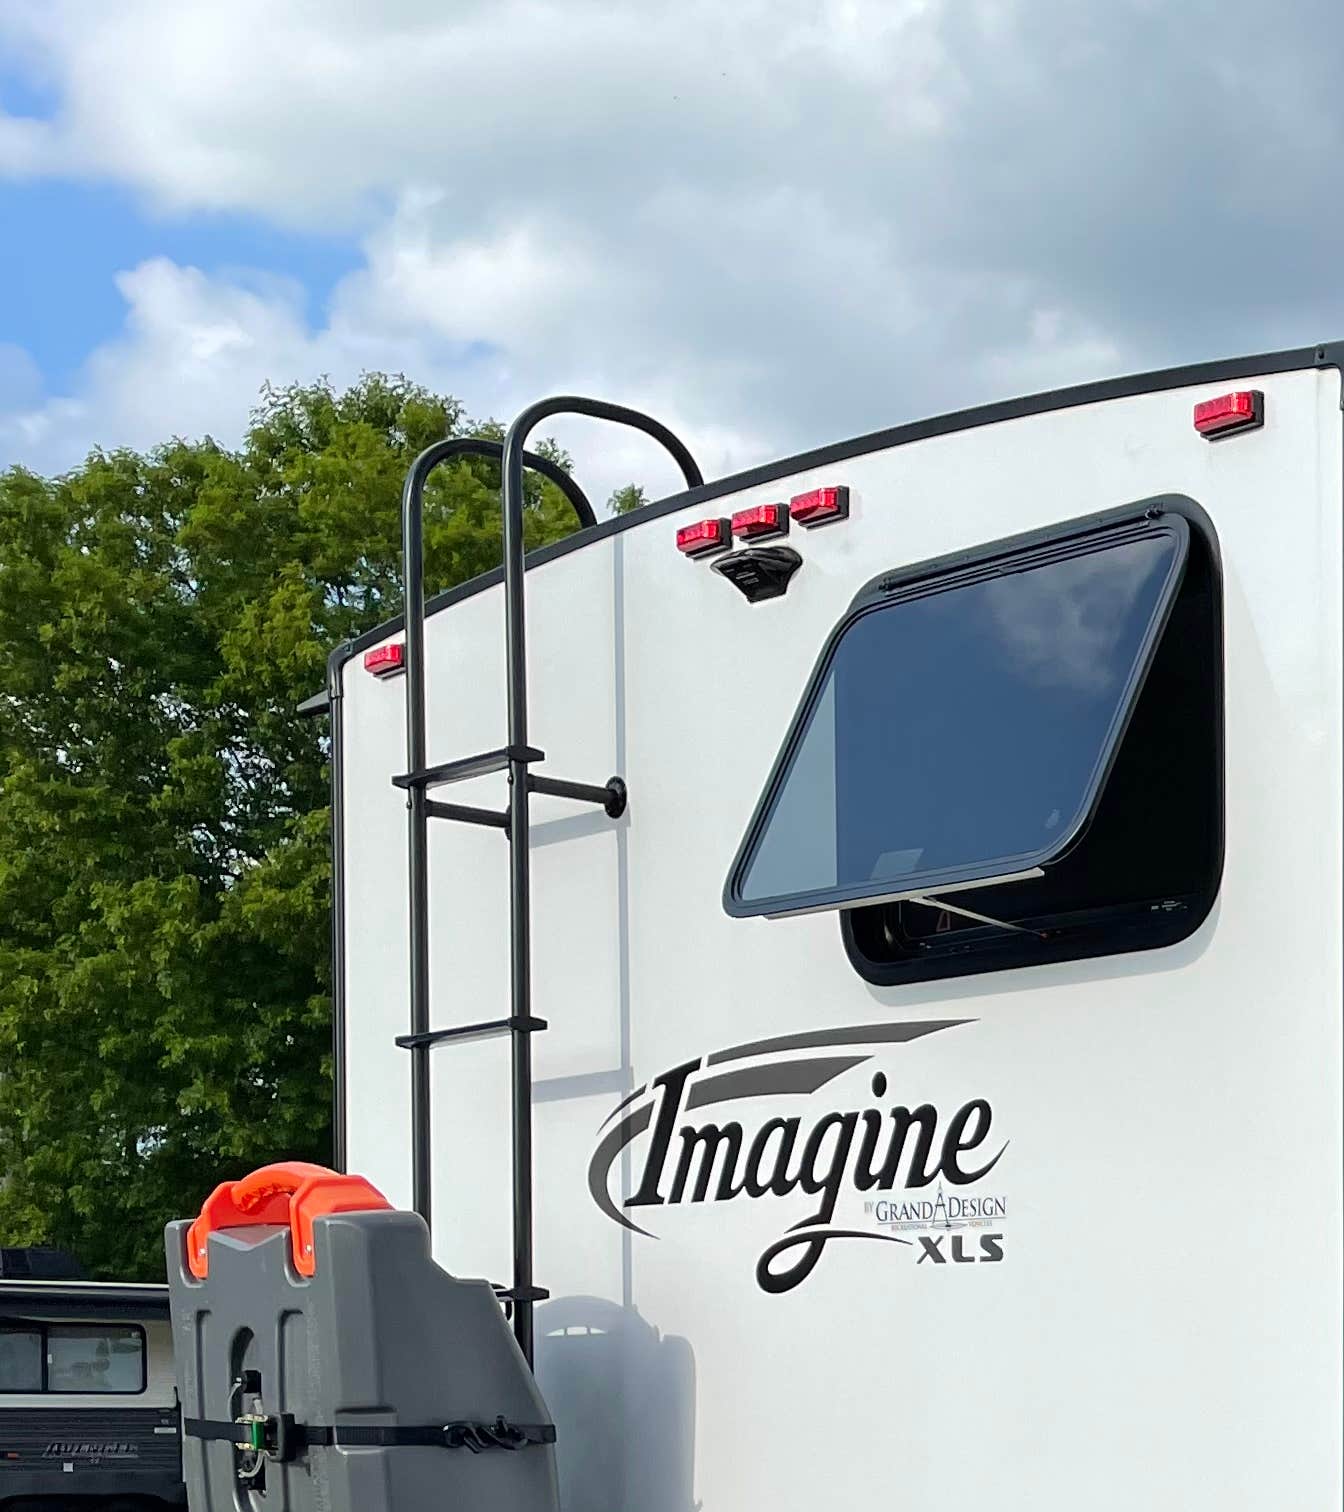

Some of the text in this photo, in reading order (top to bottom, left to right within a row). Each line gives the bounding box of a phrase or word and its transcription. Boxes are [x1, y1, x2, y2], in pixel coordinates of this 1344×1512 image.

[623, 1057, 1011, 1294] Imagine
[876, 1200, 934, 1222] GRAND
[948, 1196, 1006, 1218] DESIGN
[917, 1234, 1004, 1264] XLS
